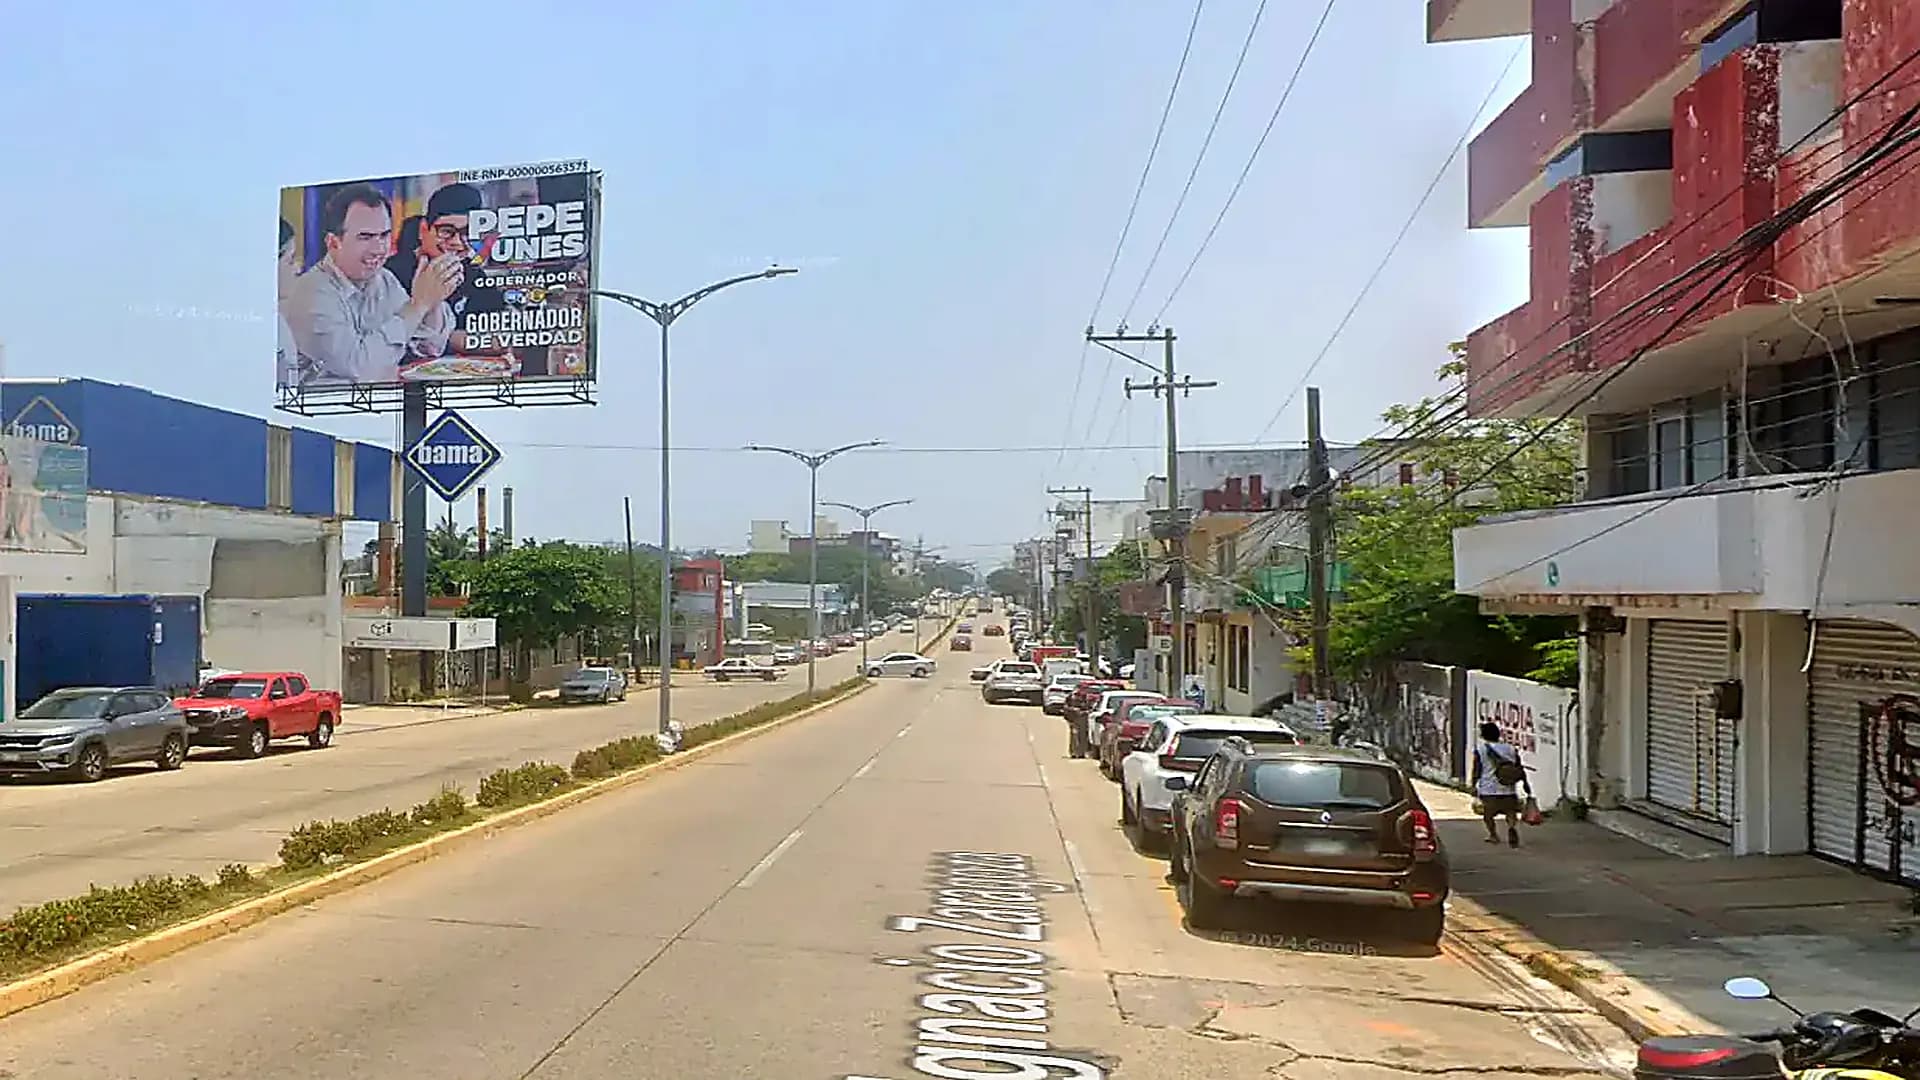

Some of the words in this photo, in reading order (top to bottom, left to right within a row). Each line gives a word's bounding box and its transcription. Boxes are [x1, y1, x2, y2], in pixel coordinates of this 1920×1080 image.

[469, 201, 584, 239] PEPE
[474, 271, 578, 288] GOBERNADOR
[466, 308, 582, 333] GOBERNADOR
[466, 335, 492, 349] DE
[499, 330, 583, 348] VERDAD
[418, 440, 483, 464] bama
